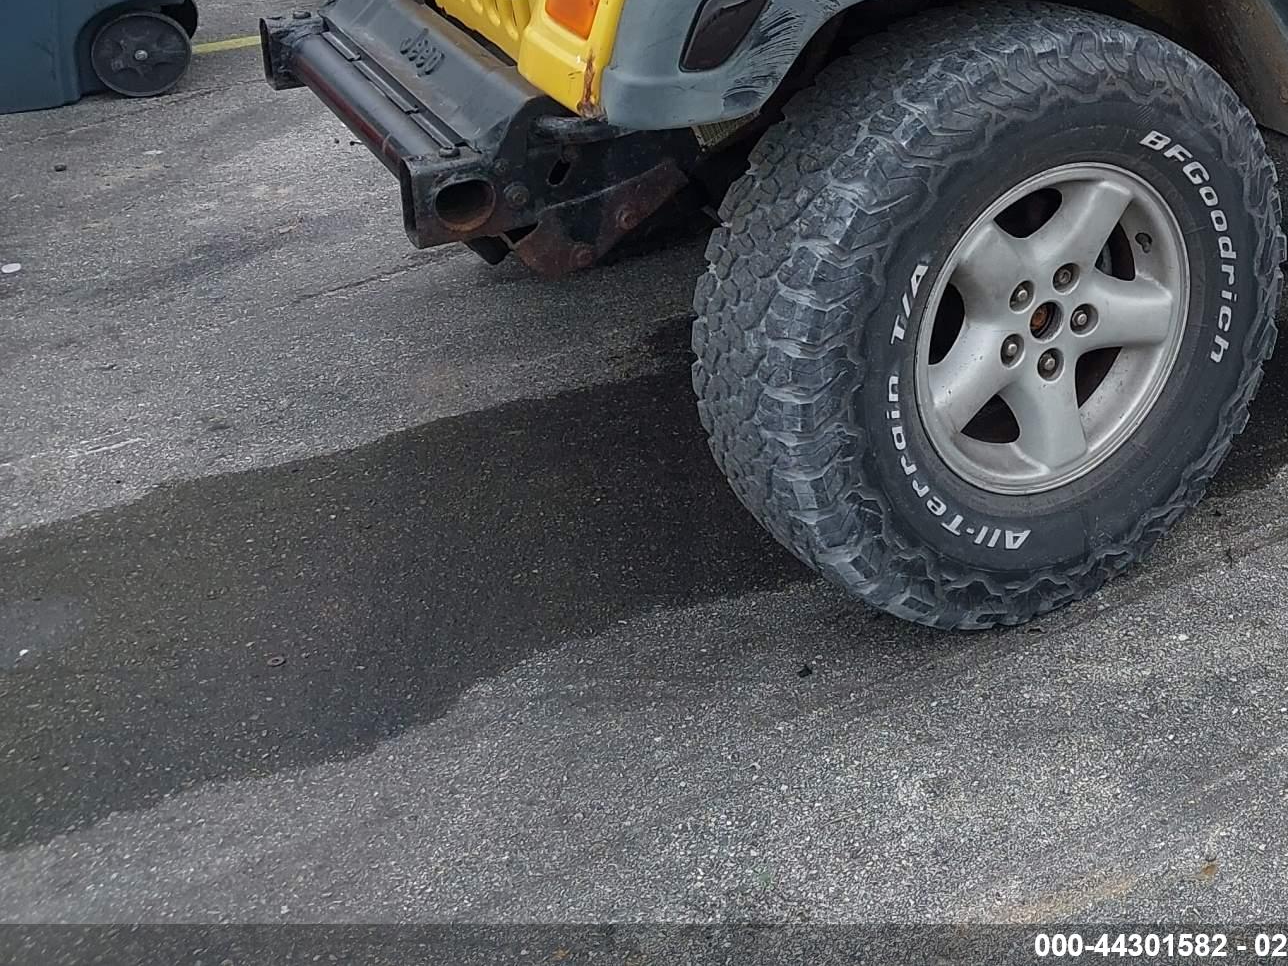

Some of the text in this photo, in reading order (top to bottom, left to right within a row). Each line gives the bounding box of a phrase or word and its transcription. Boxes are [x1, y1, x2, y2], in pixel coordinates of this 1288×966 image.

[1139, 130, 1238, 363] BFGoodrich
[886, 264, 1031, 550] All-Terrain T/A
